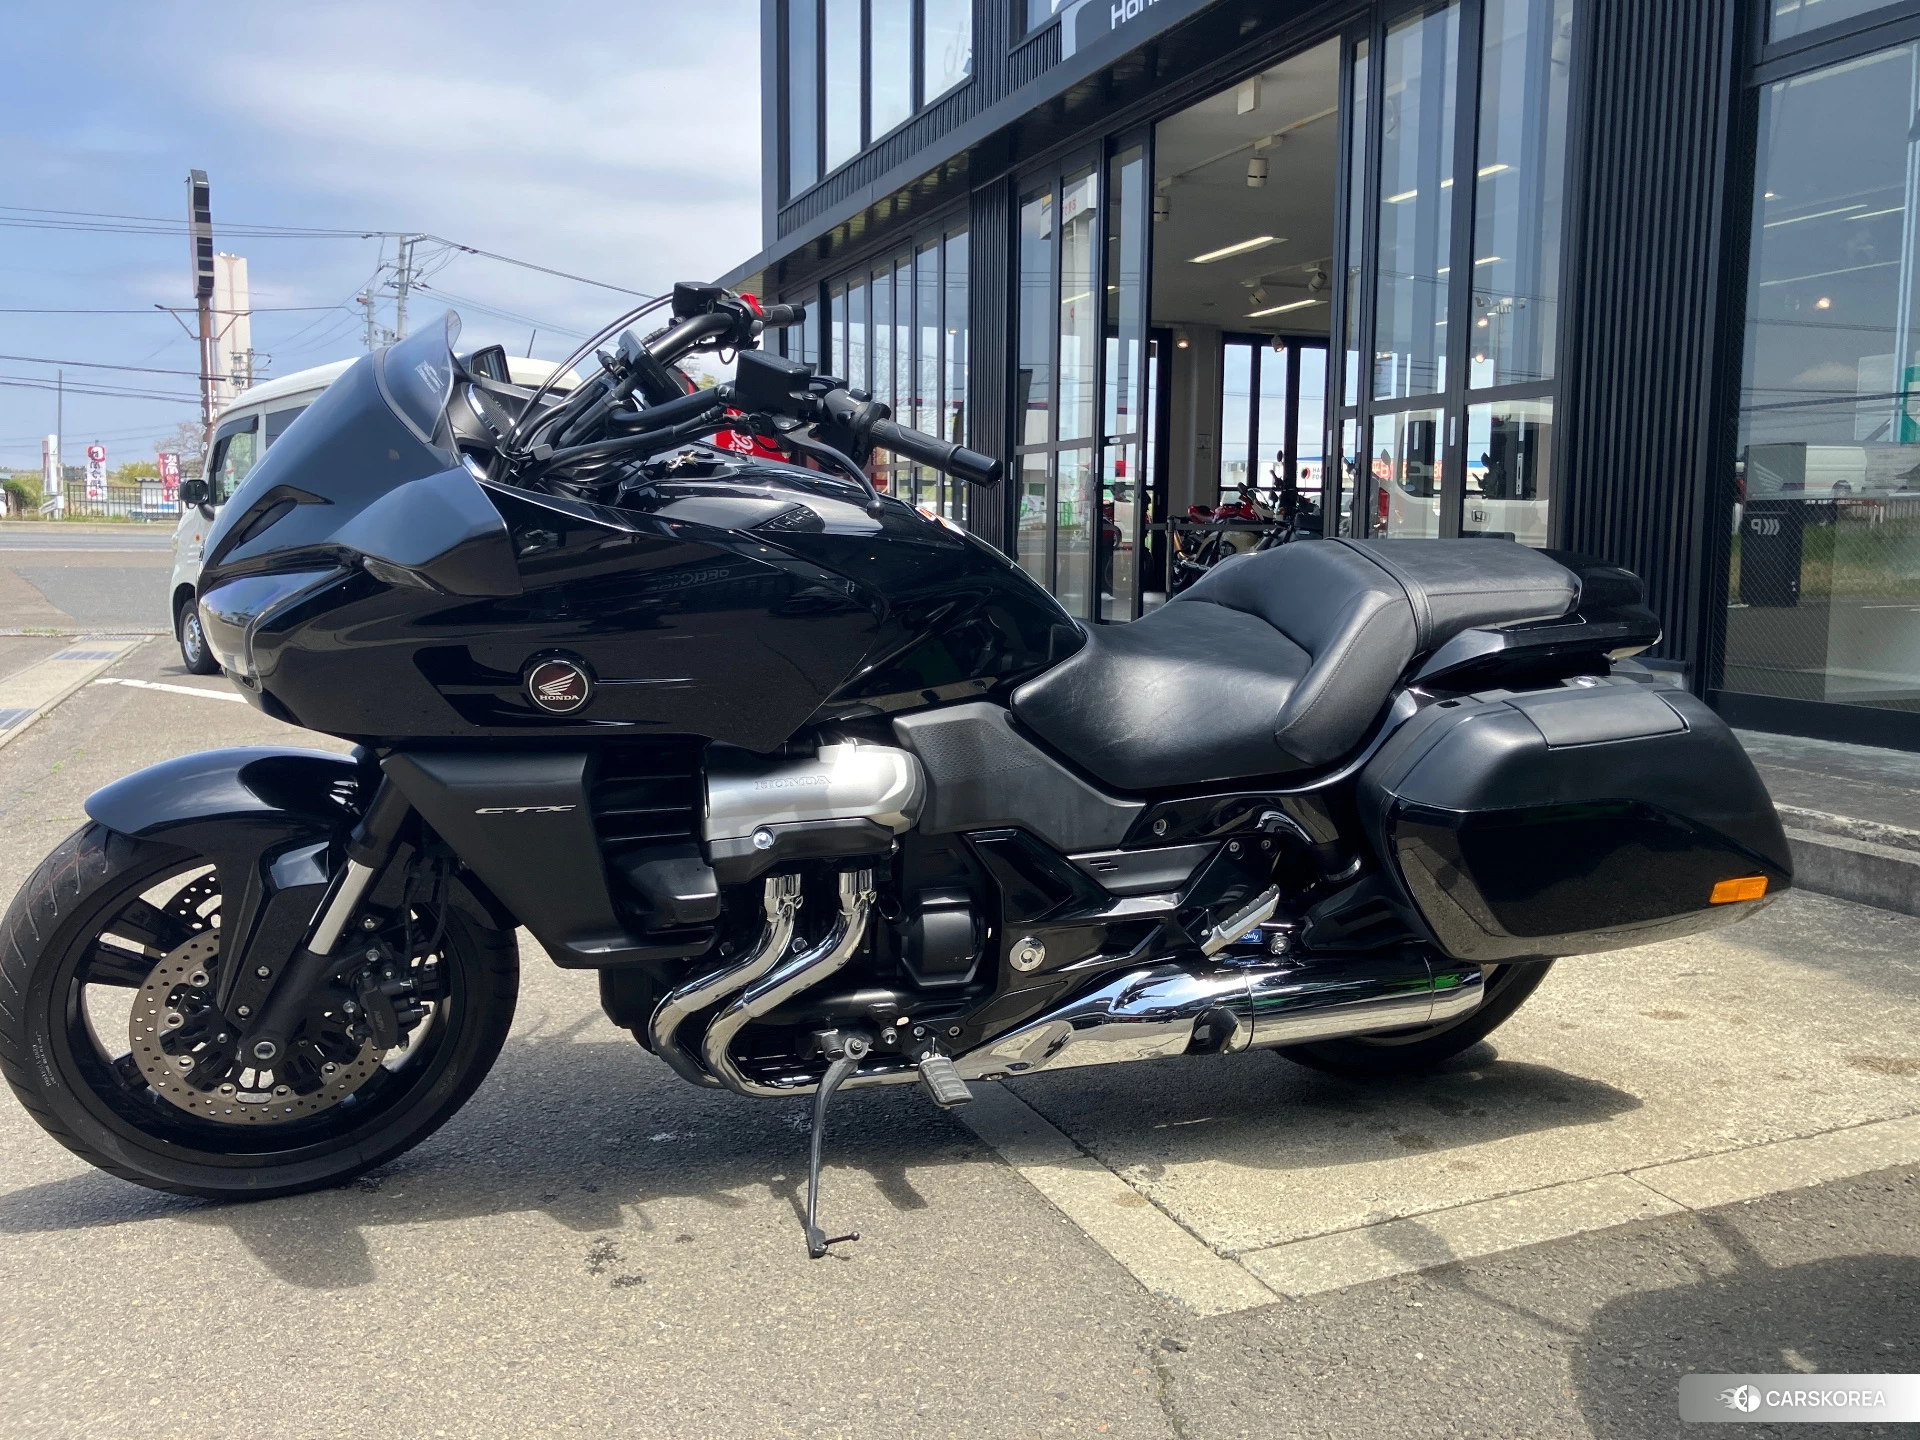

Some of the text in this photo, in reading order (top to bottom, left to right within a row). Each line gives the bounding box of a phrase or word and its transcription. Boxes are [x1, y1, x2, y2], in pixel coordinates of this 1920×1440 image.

[1111, 0, 1160, 30] Hon
[755, 775, 831, 791] HONDA
[474, 804, 577, 814] CTX
